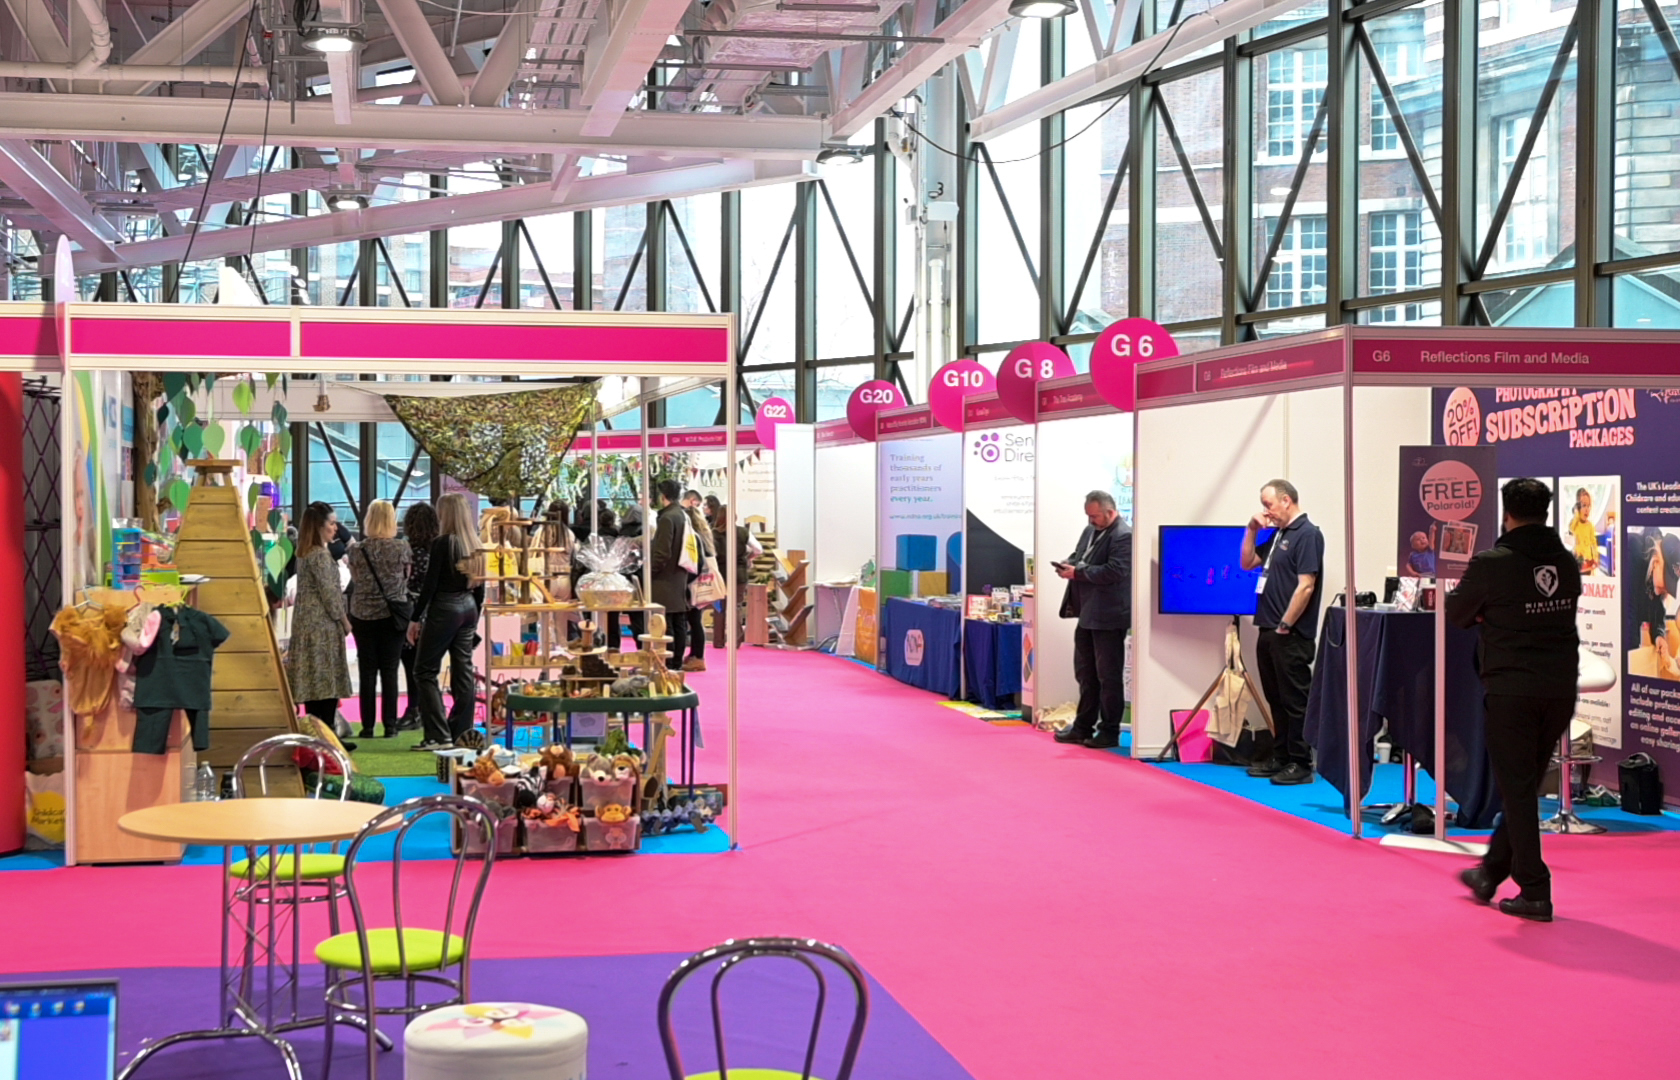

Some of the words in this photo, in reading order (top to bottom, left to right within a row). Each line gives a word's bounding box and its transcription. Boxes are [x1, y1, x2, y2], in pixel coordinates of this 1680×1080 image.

[1111, 334, 1130, 356] G
[1138, 335, 1153, 357] 6
[1372, 350, 1391, 362] G6
[1420, 350, 1491, 364] Reflections
[1494, 351, 1521, 364] Film
[1524, 351, 1547, 364] and
[1551, 352, 1590, 364] Media
[1014, 358, 1032, 378] G
[1040, 359, 1054, 378] 8
[943, 369, 984, 387] G10
[860, 388, 893, 404] G20
[763, 404, 787, 418] G22
[1447, 397, 1474, 428] 20%
[1449, 417, 1479, 446] OFF!
[1569, 426, 1634, 448] PACKAGES
[890, 454, 925, 463] Training
[890, 464, 932, 472] thousands
[933, 464, 942, 472] of
[890, 475, 910, 483] early
[890, 485, 942, 494] practitioners
[1422, 480, 1480, 502] FREE
[1636, 481, 1647, 491] The
[1648, 481, 1661, 491] UK's
[890, 495, 911, 504] every
[913, 496, 934, 504] year.
[1625, 493, 1654, 503] Childcare
[1655, 493, 1667, 502] and
[1427, 500, 1475, 512] Polaroid!
[1525, 598, 1572, 609] MINISTRY
[1631, 682, 1641, 693] All
[1641, 684, 1649, 694] of
[1649, 687, 1660, 695] our
[1629, 694, 1653, 707] include
[1628, 707, 1651, 722] editing
[1651, 711, 1665, 722] and
[1639, 722, 1660, 733] online
[1640, 736, 1656, 748] easy
